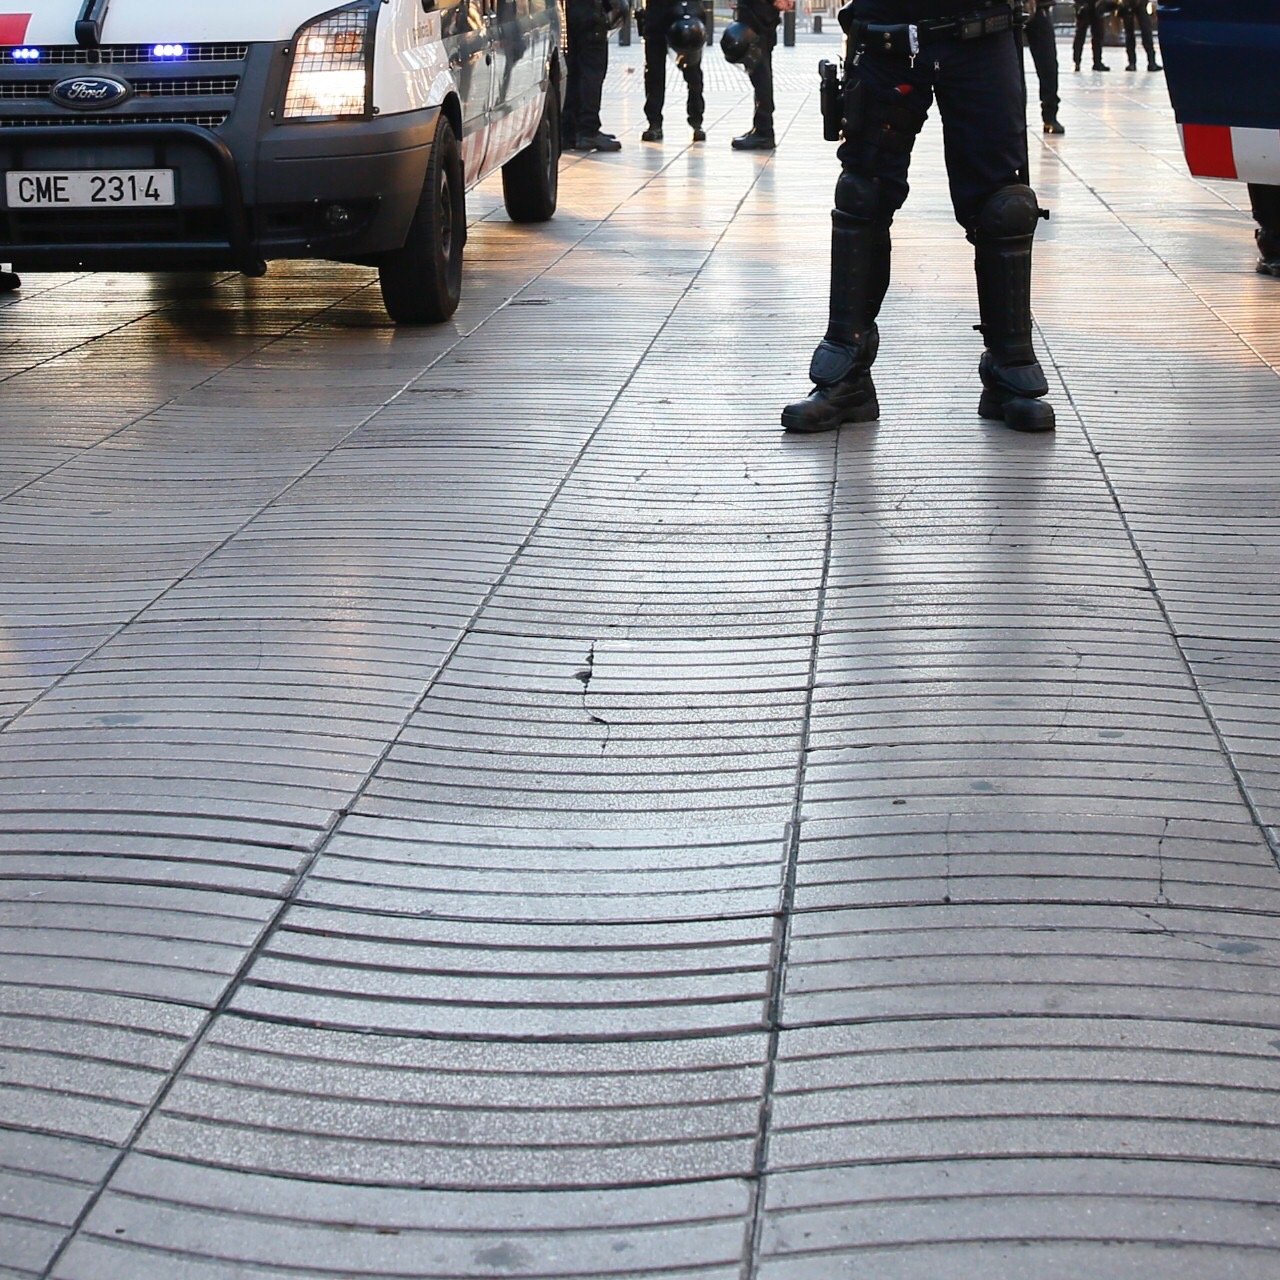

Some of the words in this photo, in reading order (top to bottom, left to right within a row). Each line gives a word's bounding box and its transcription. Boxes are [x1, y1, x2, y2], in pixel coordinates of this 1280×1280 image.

[67, 81, 108, 99] Ford
[19, 176, 70, 203] CME
[90, 175, 160, 203] 2314
